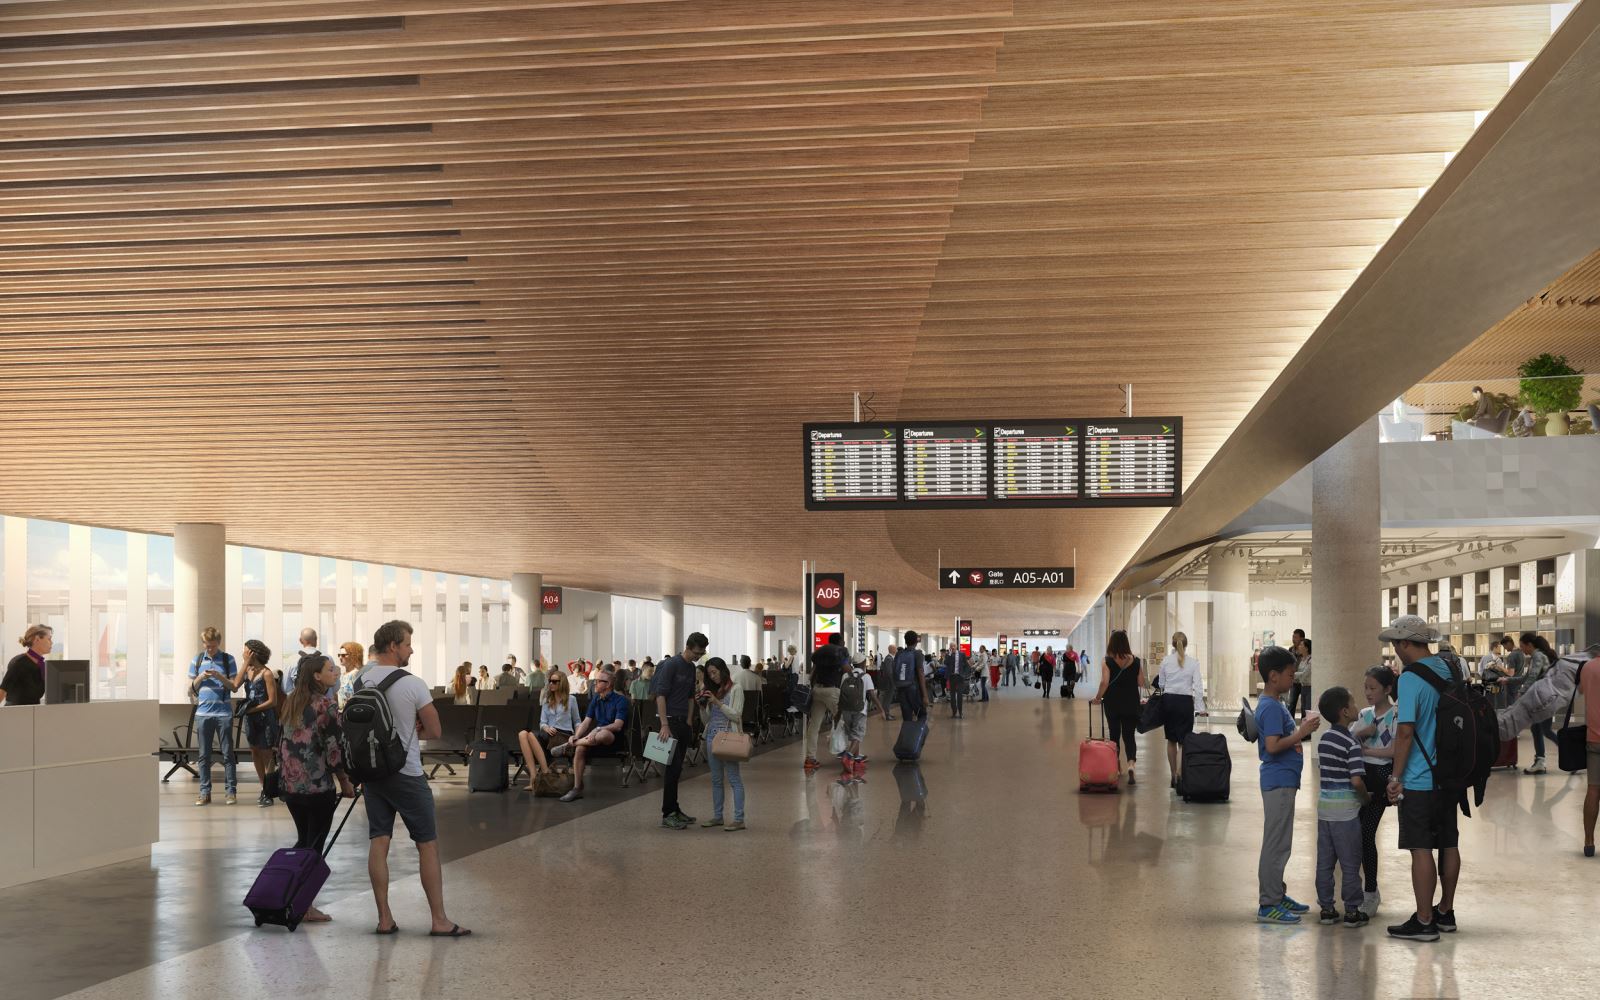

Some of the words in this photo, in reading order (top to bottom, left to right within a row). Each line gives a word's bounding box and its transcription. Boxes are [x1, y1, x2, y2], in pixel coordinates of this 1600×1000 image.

[1094, 427, 1118, 435] Departures
[818, 432, 842, 440] Departures
[1013, 572, 1064, 583] A05-A01
[817, 588, 840, 599] A05
[543, 596, 559, 604] A04
